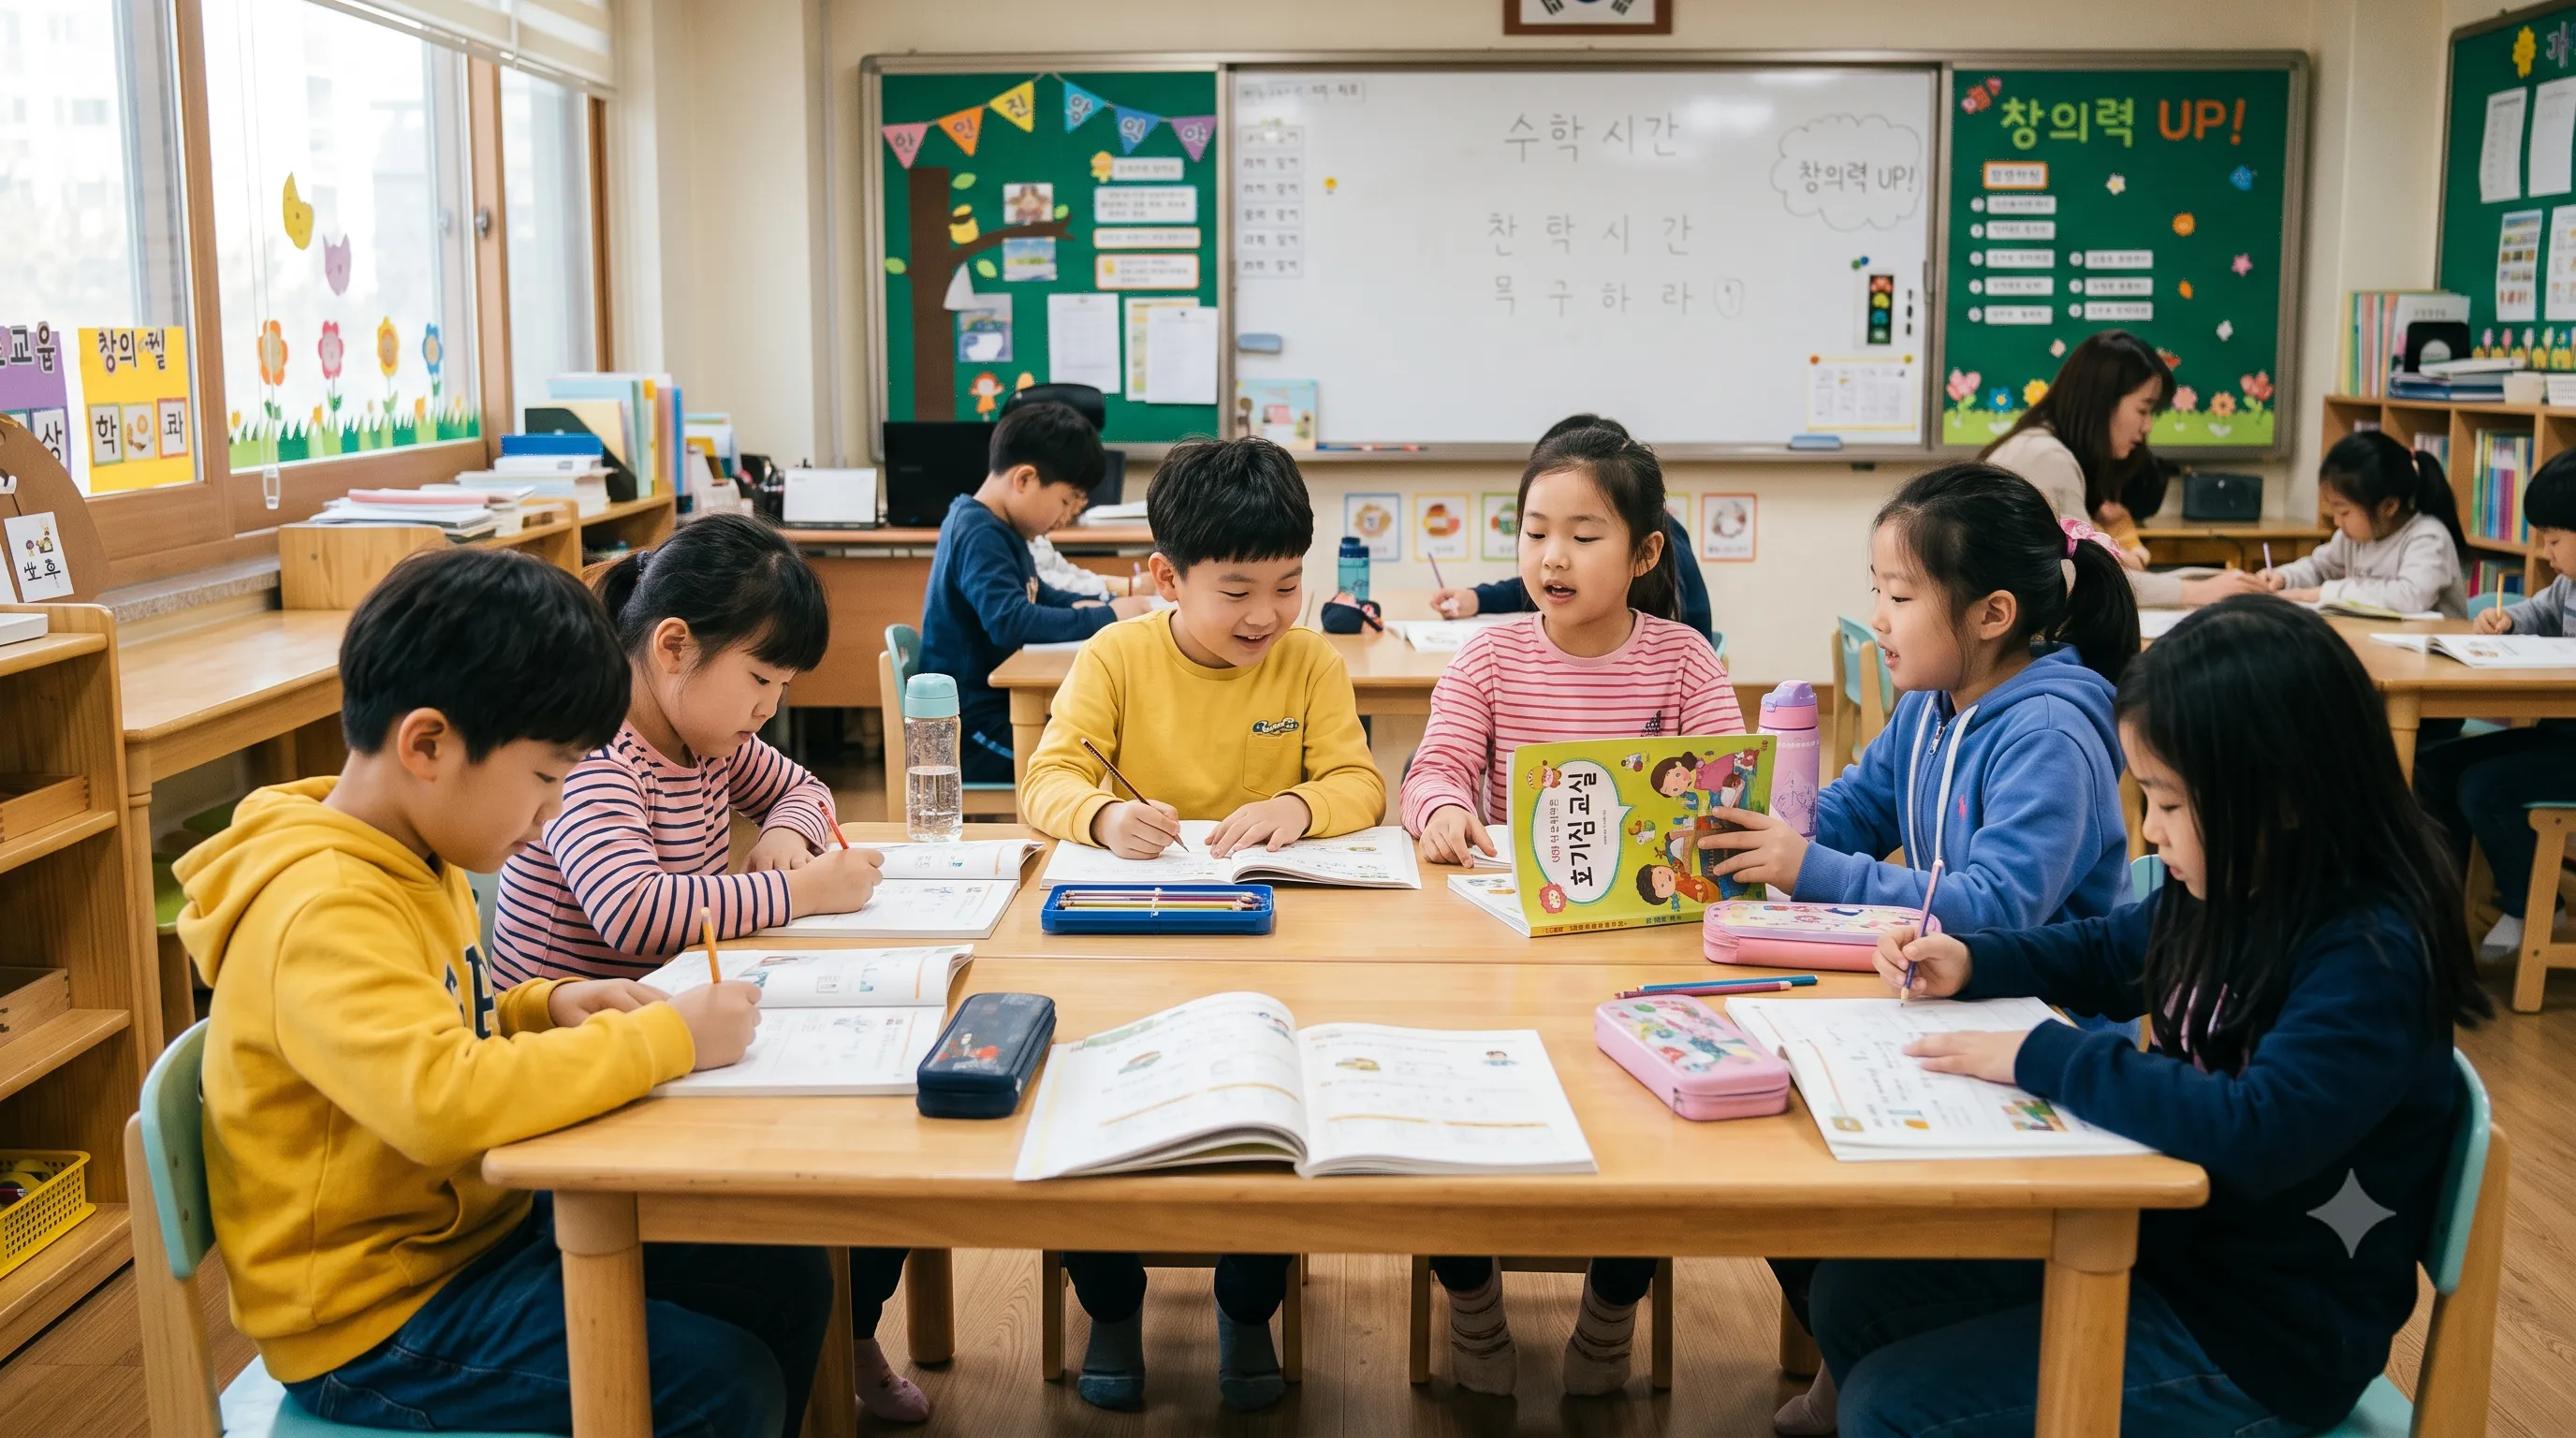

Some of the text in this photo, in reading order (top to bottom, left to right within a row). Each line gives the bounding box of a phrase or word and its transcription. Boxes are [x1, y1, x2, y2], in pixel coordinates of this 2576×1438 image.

[1503, 112, 1680, 164] 수학 시간
[2000, 97, 2247, 150] 창의력 UP!
[1799, 160, 1915, 194] 창의력 UP!
